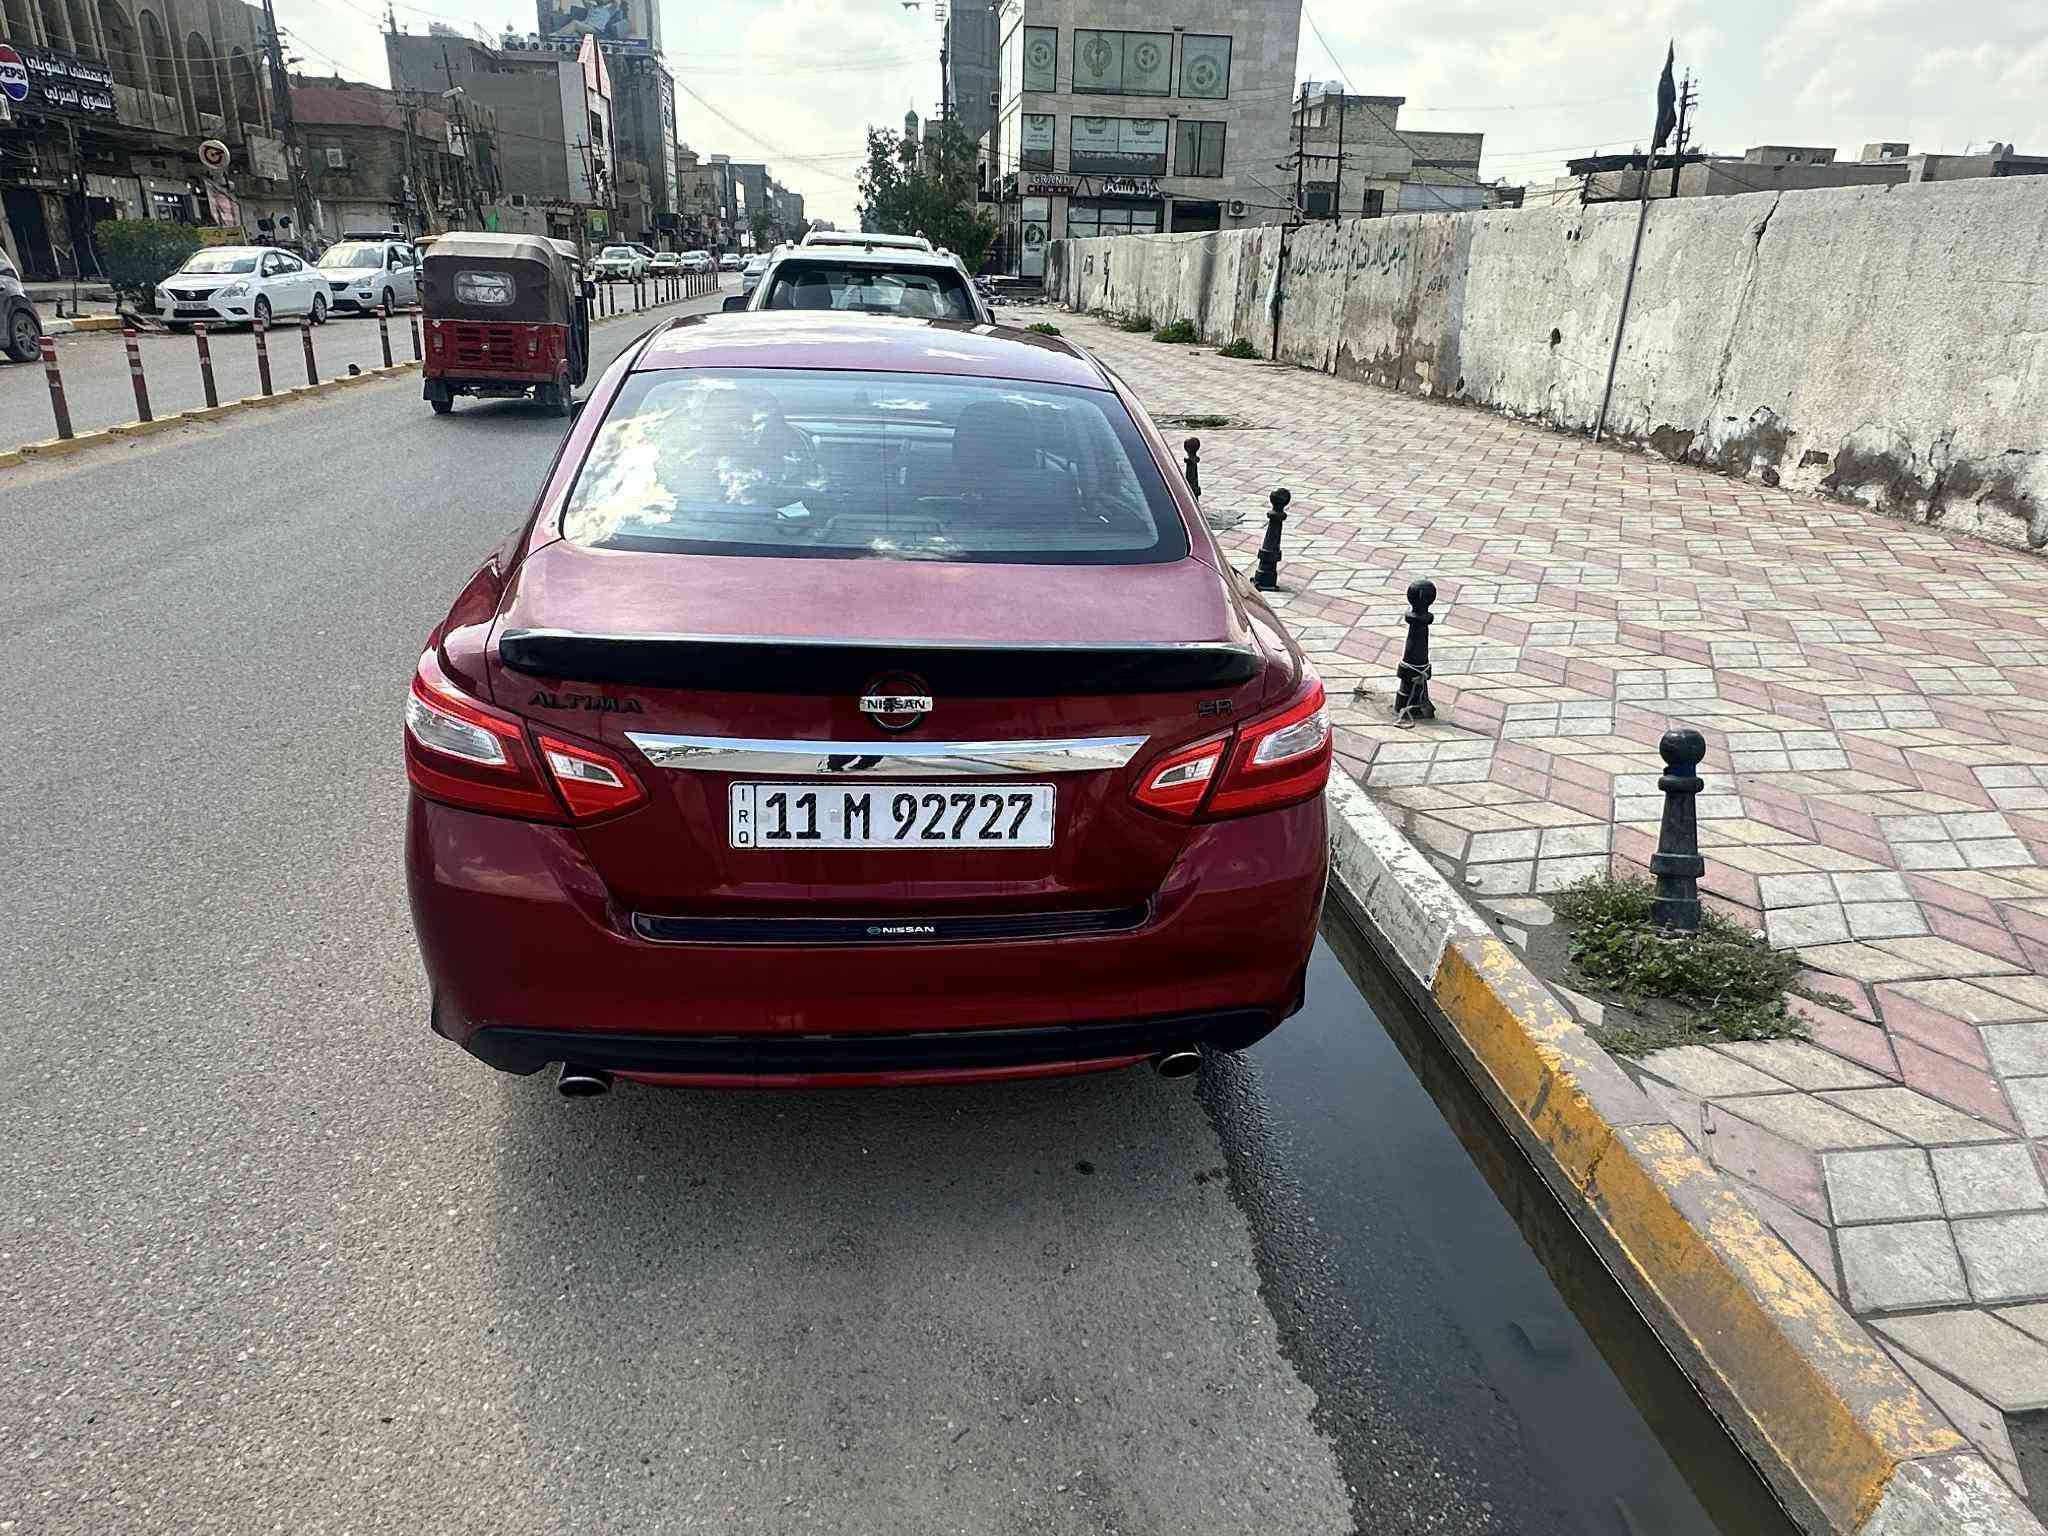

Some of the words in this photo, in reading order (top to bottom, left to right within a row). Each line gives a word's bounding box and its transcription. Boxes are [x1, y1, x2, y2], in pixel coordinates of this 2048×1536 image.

[1032, 174, 1071, 184] GRAND
[528, 691, 644, 714] ALTIMA
[1198, 699, 1233, 715] SR
[738, 788, 749, 844] IRQ
[765, 792, 822, 840] 11
[843, 792, 871, 840] M
[891, 792, 1033, 840] 92727
[882, 926, 935, 934] NISSAN
